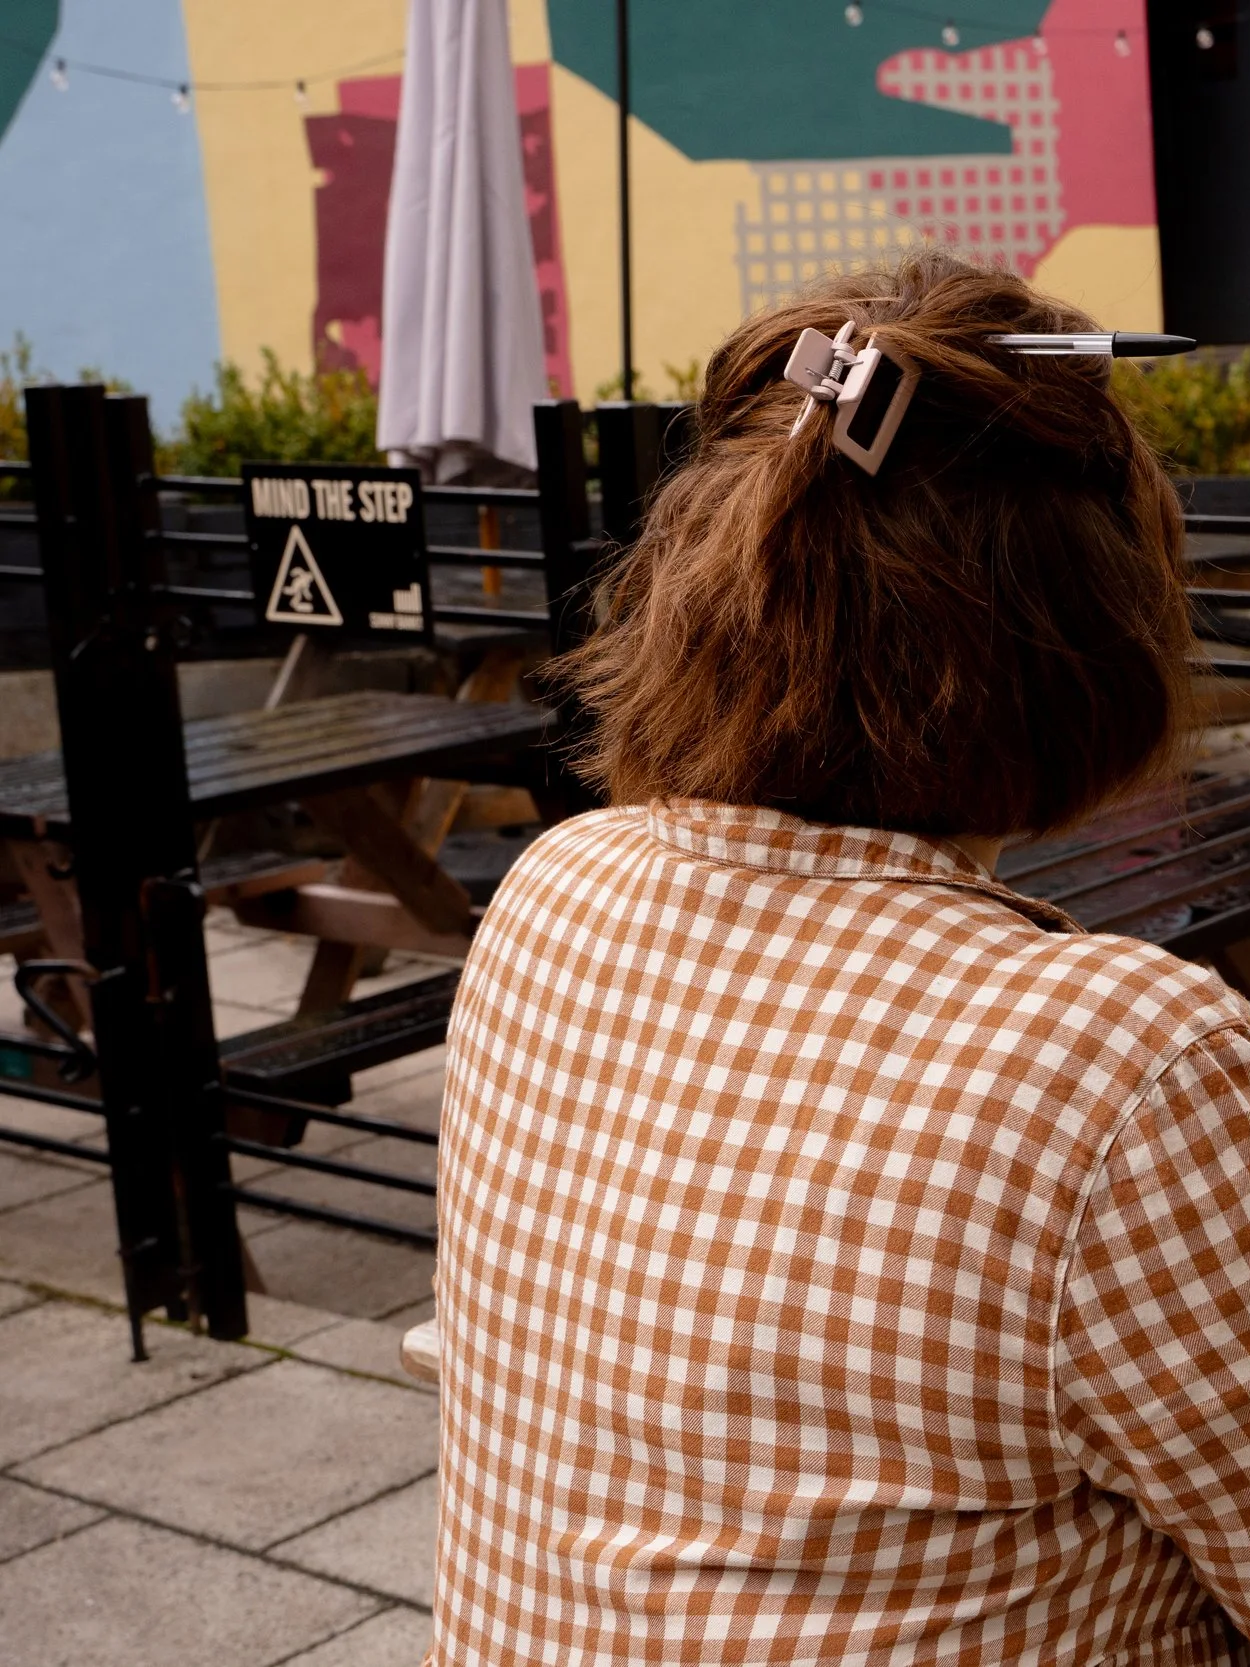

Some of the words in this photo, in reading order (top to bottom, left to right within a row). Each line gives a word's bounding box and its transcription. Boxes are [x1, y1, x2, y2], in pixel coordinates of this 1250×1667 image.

[251, 477, 311, 519] MIND
[311, 479, 356, 521] THE
[358, 481, 413, 523] STEP
